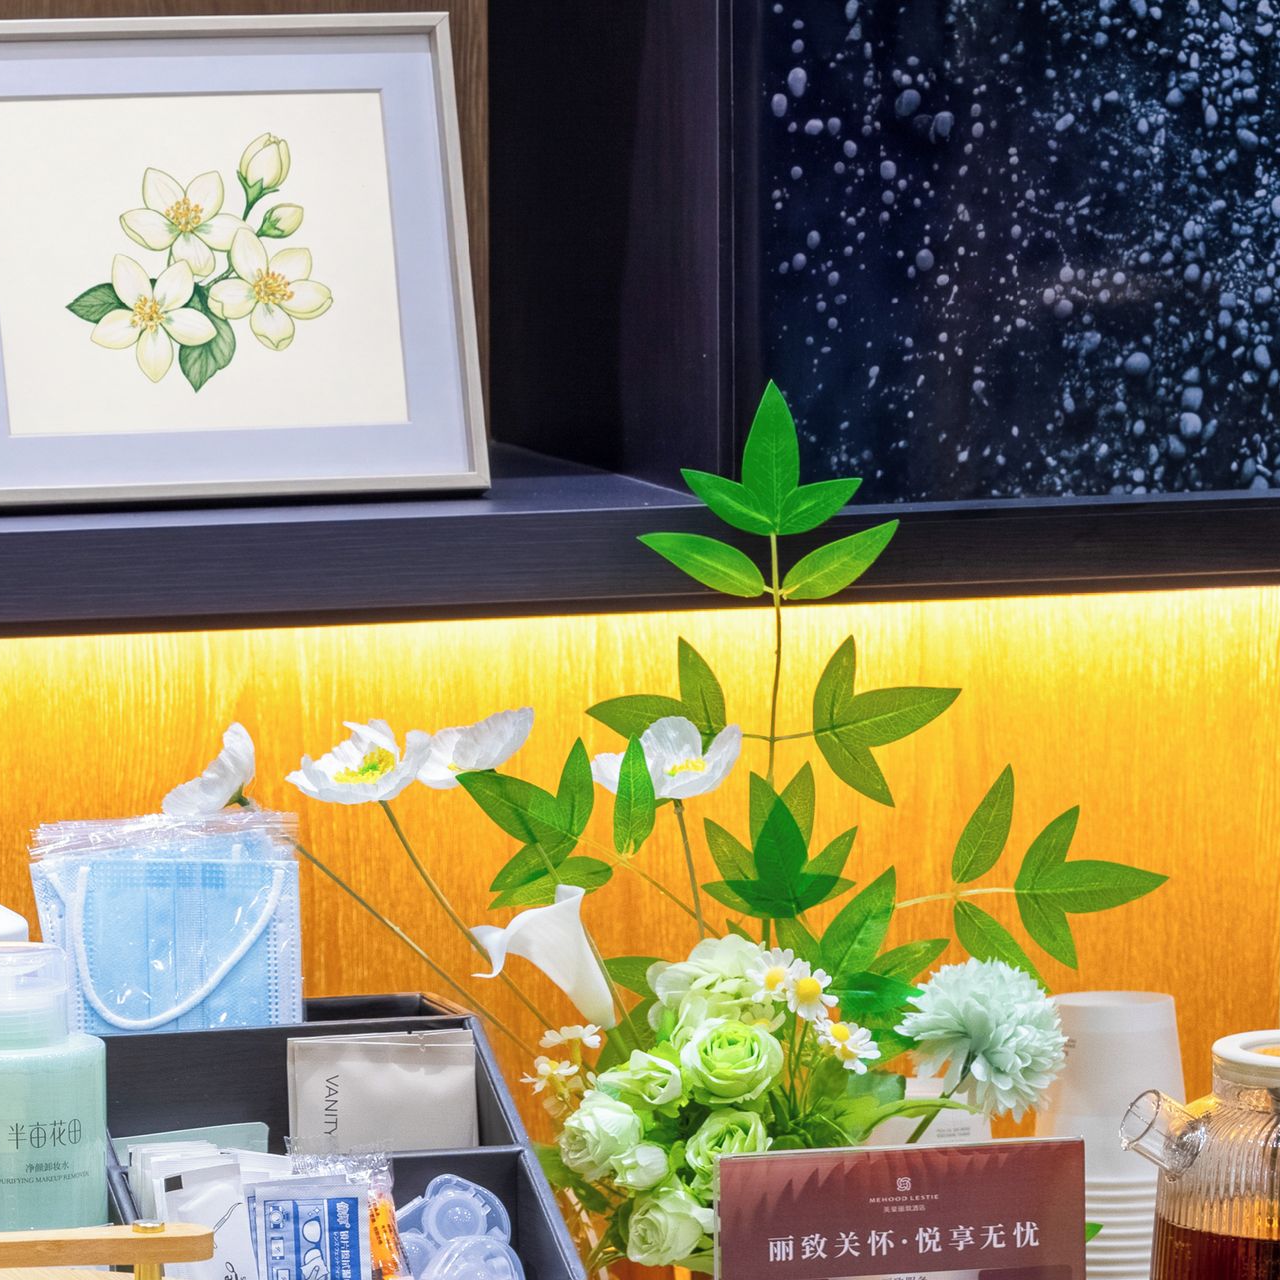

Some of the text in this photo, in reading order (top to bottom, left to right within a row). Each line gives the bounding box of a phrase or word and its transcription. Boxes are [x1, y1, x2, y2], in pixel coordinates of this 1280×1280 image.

[324, 1074, 339, 1136] VANITY
[8, 1118, 81, 1150] 半亩花田
[35, 1174, 63, 1183] MAKEUP
[869, 1194, 939, 1204] MEHOOD LESTIE
[768, 1221, 1040, 1263] 丽致关怀·悦享无忧
